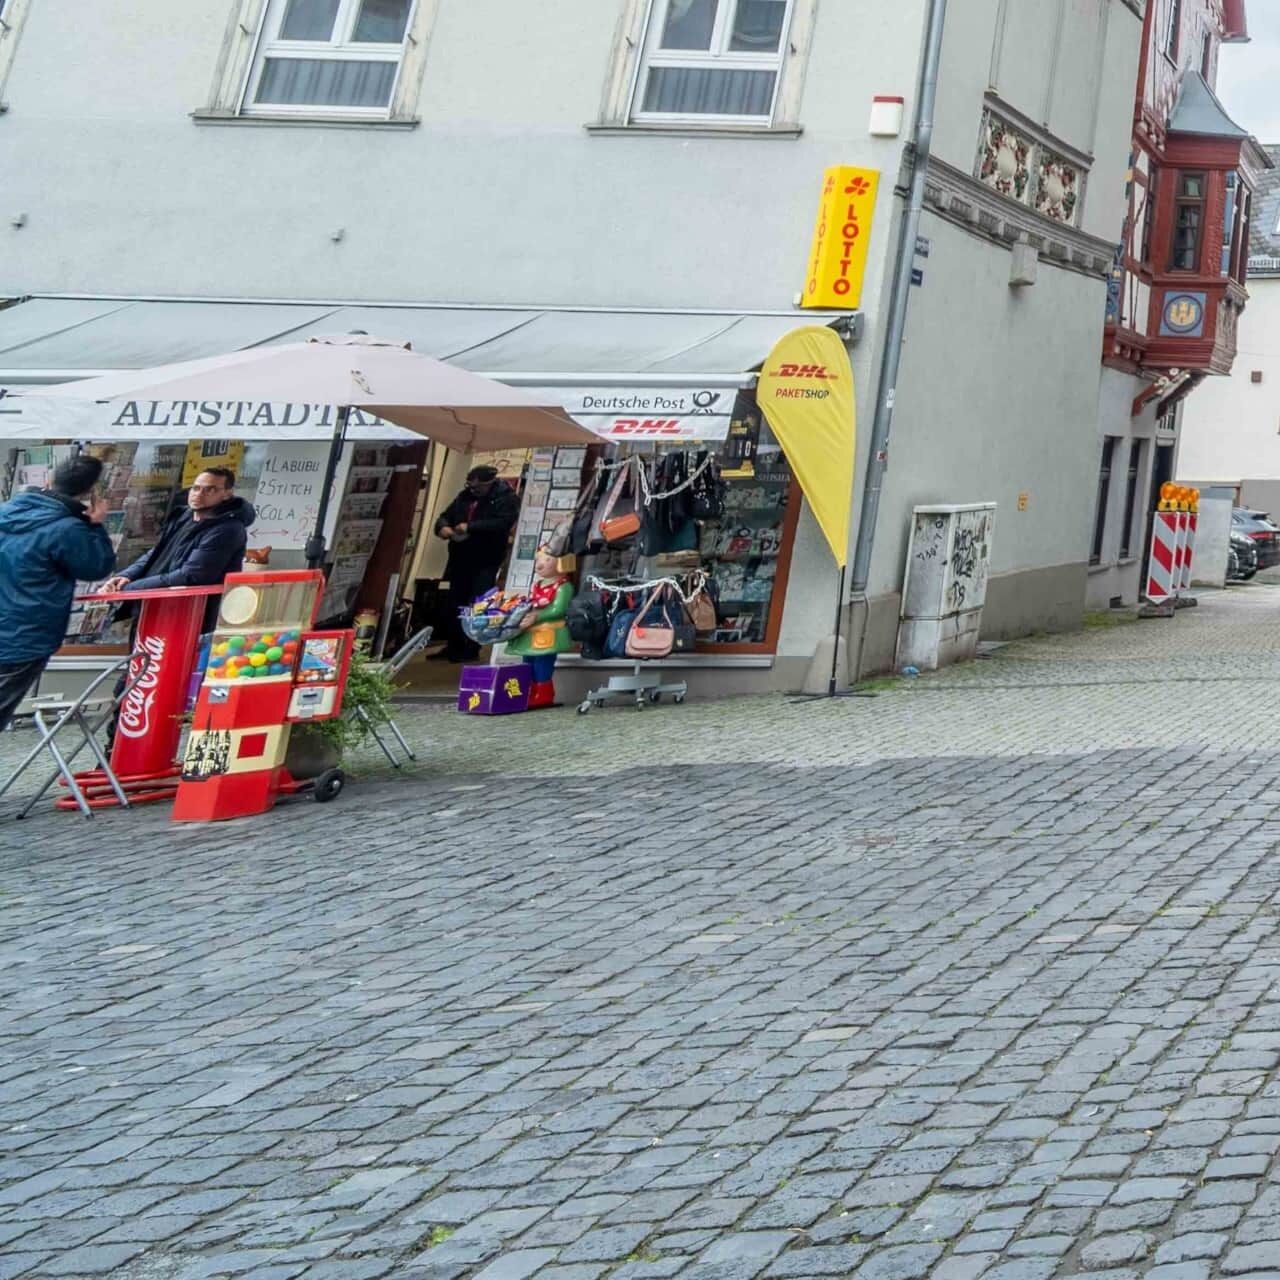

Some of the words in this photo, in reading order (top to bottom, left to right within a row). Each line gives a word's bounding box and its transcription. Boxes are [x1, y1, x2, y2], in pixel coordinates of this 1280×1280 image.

[833, 204, 860, 296] LOTTO
[778, 363, 829, 379] DHL
[775, 387, 830, 400] PAKETSHOP
[582, 396, 650, 409] Deutsche
[654, 397, 686, 410] Post
[611, 419, 682, 435] DHL
